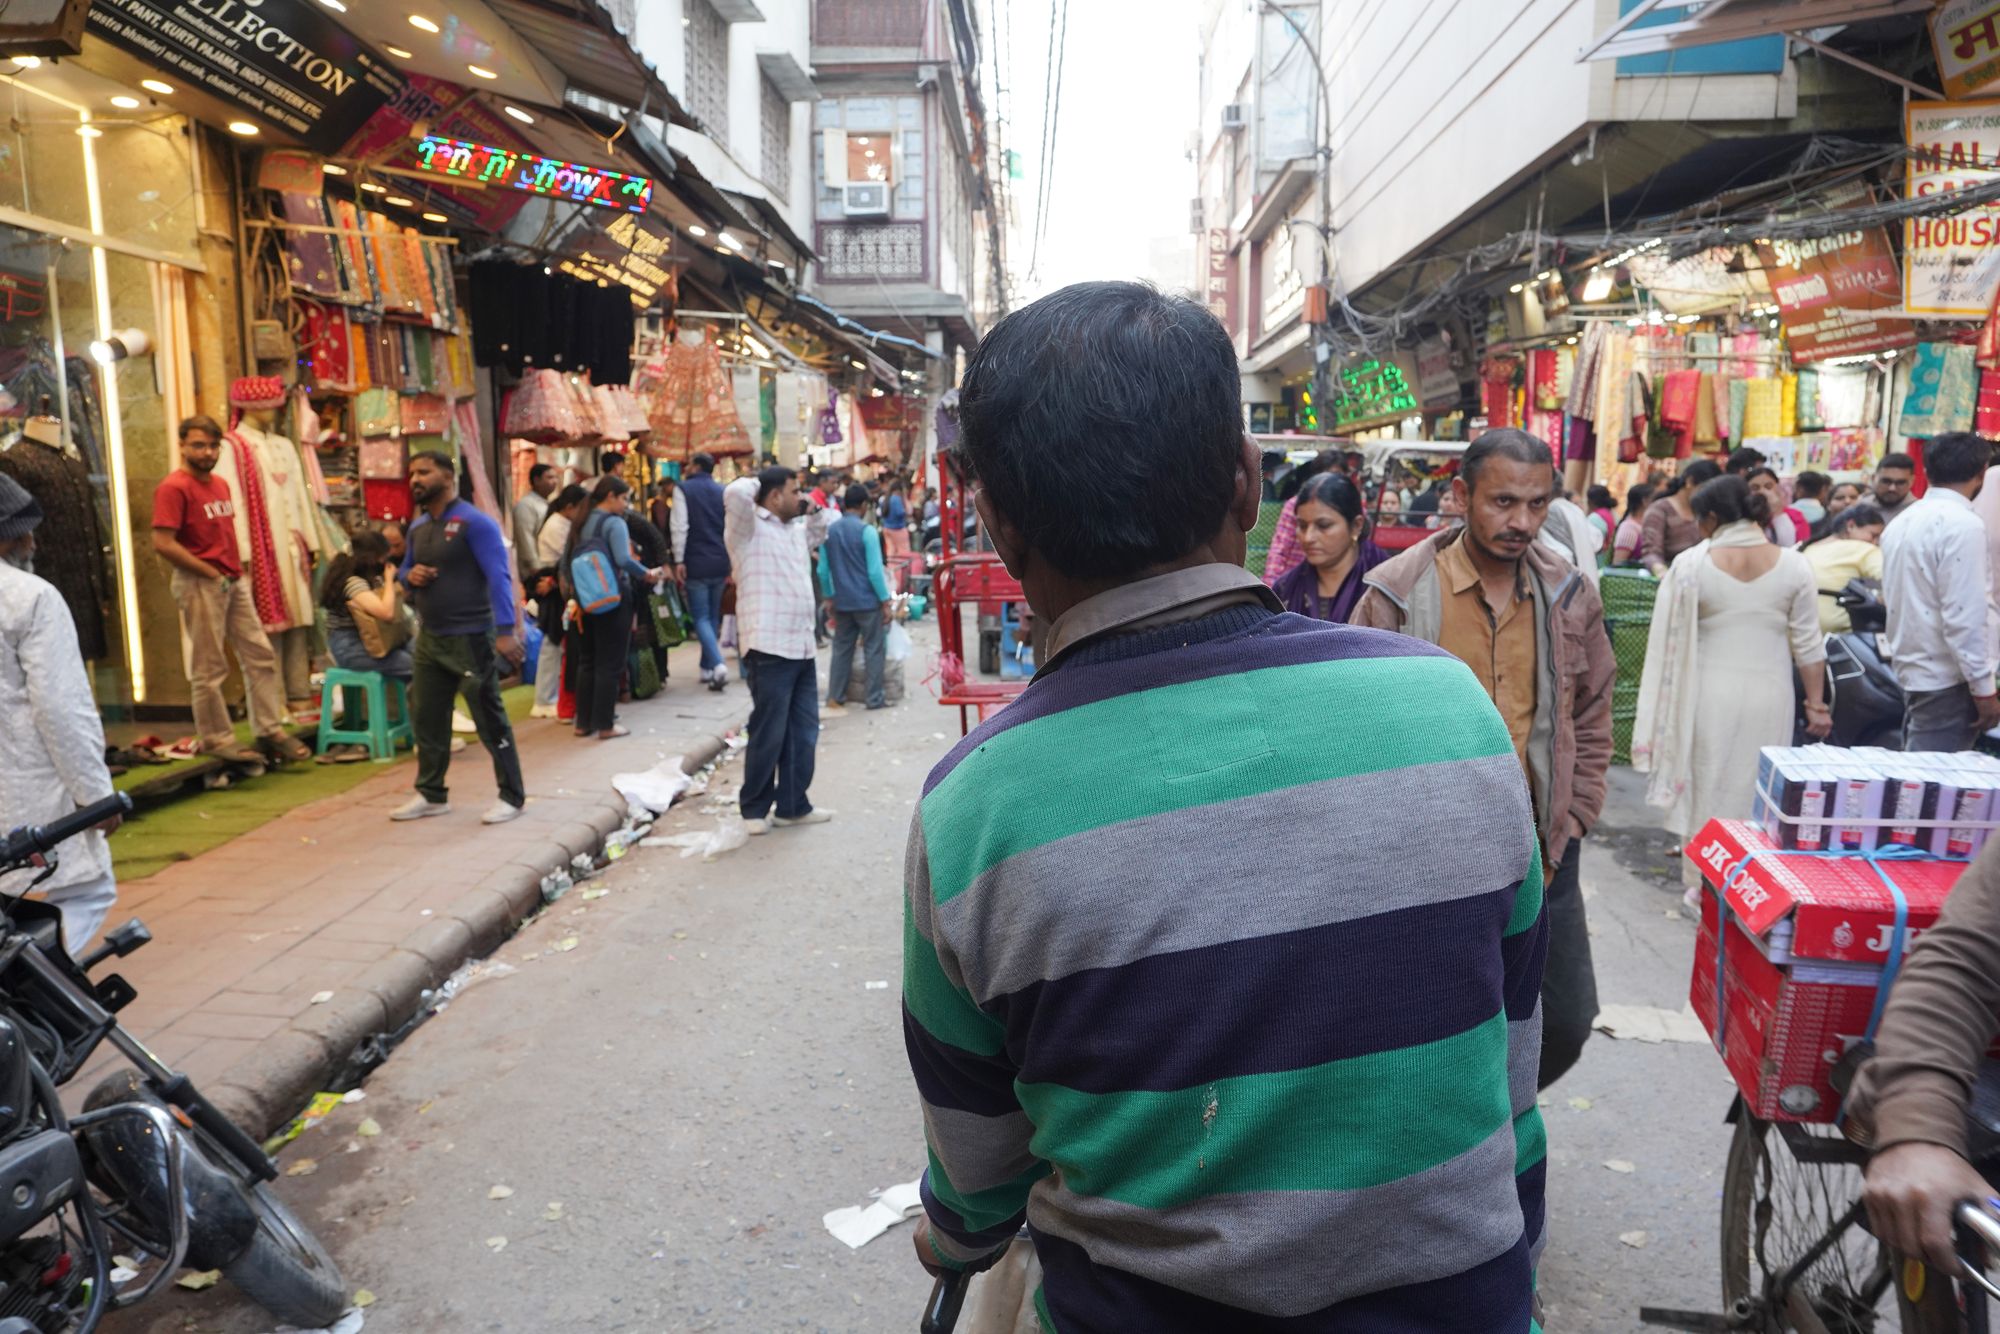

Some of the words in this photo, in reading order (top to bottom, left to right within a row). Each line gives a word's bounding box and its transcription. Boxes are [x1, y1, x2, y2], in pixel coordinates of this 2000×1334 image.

[88, 8, 122, 32] vastra
[120, 25, 167, 58] bhandar)
[126, 1, 163, 29] PANT,
[160, 20, 200, 50] KURTA
[197, 42, 241, 76] PAJAMA,
[1701, 840, 1732, 873] JK
